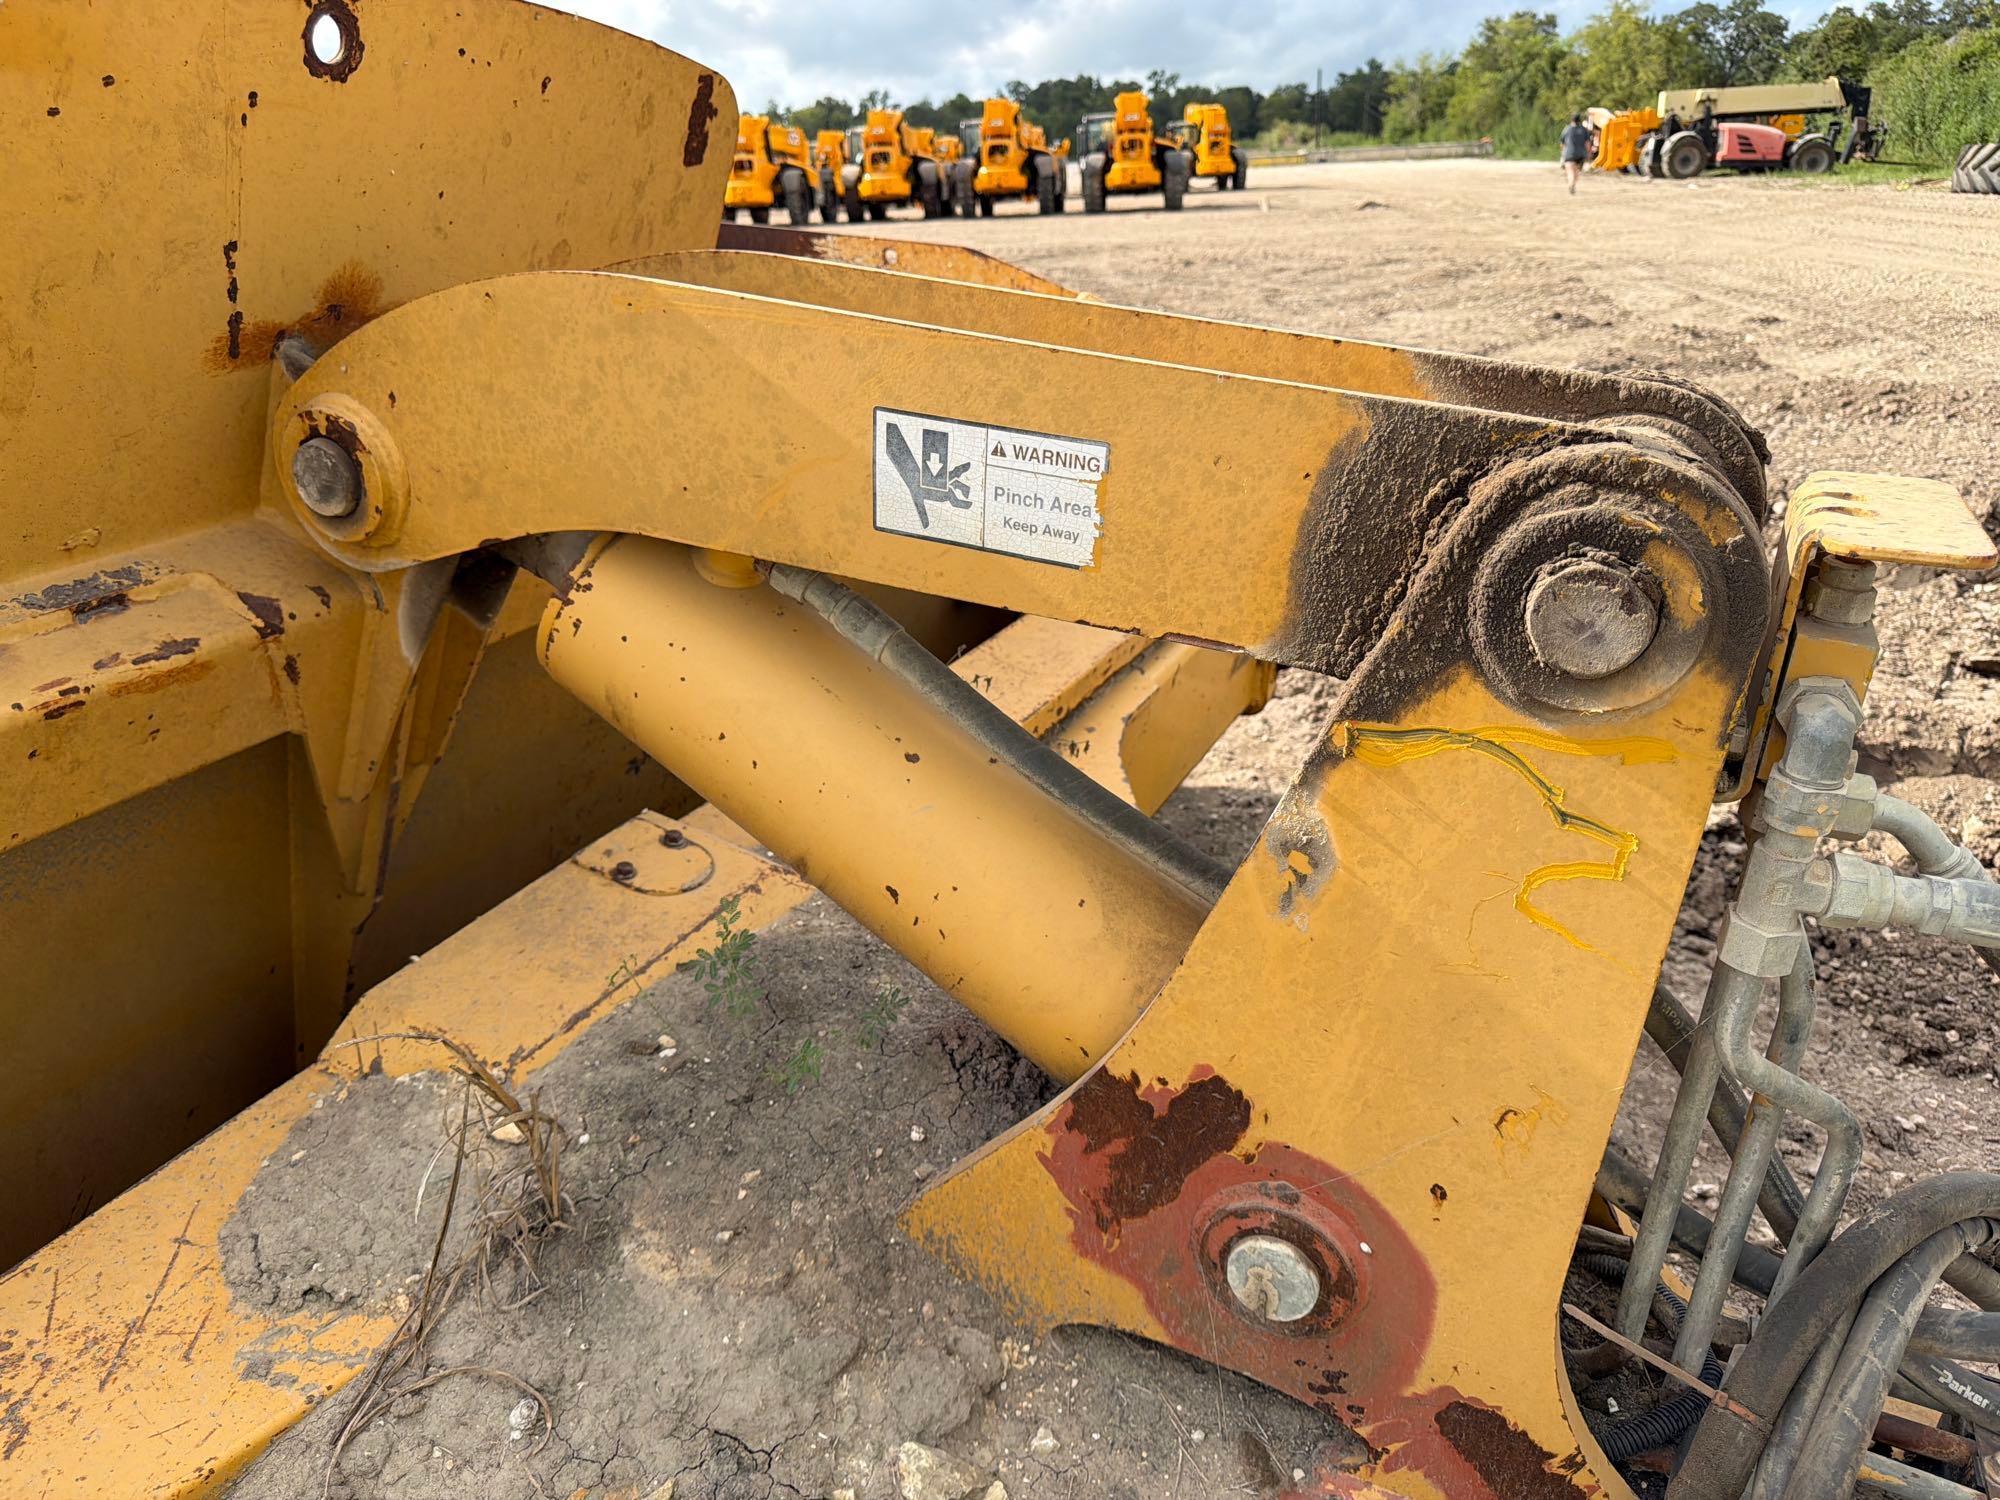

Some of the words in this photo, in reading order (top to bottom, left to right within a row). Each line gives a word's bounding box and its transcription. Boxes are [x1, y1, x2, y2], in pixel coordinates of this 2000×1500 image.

[1012, 443, 1101, 473] WARNING
[994, 486, 1044, 510] Pinch
[1050, 496, 1092, 519] Area
[1003, 516, 1038, 535] Keep
[1042, 525, 1080, 544] Away
[1932, 1366, 1990, 1409] Parker
